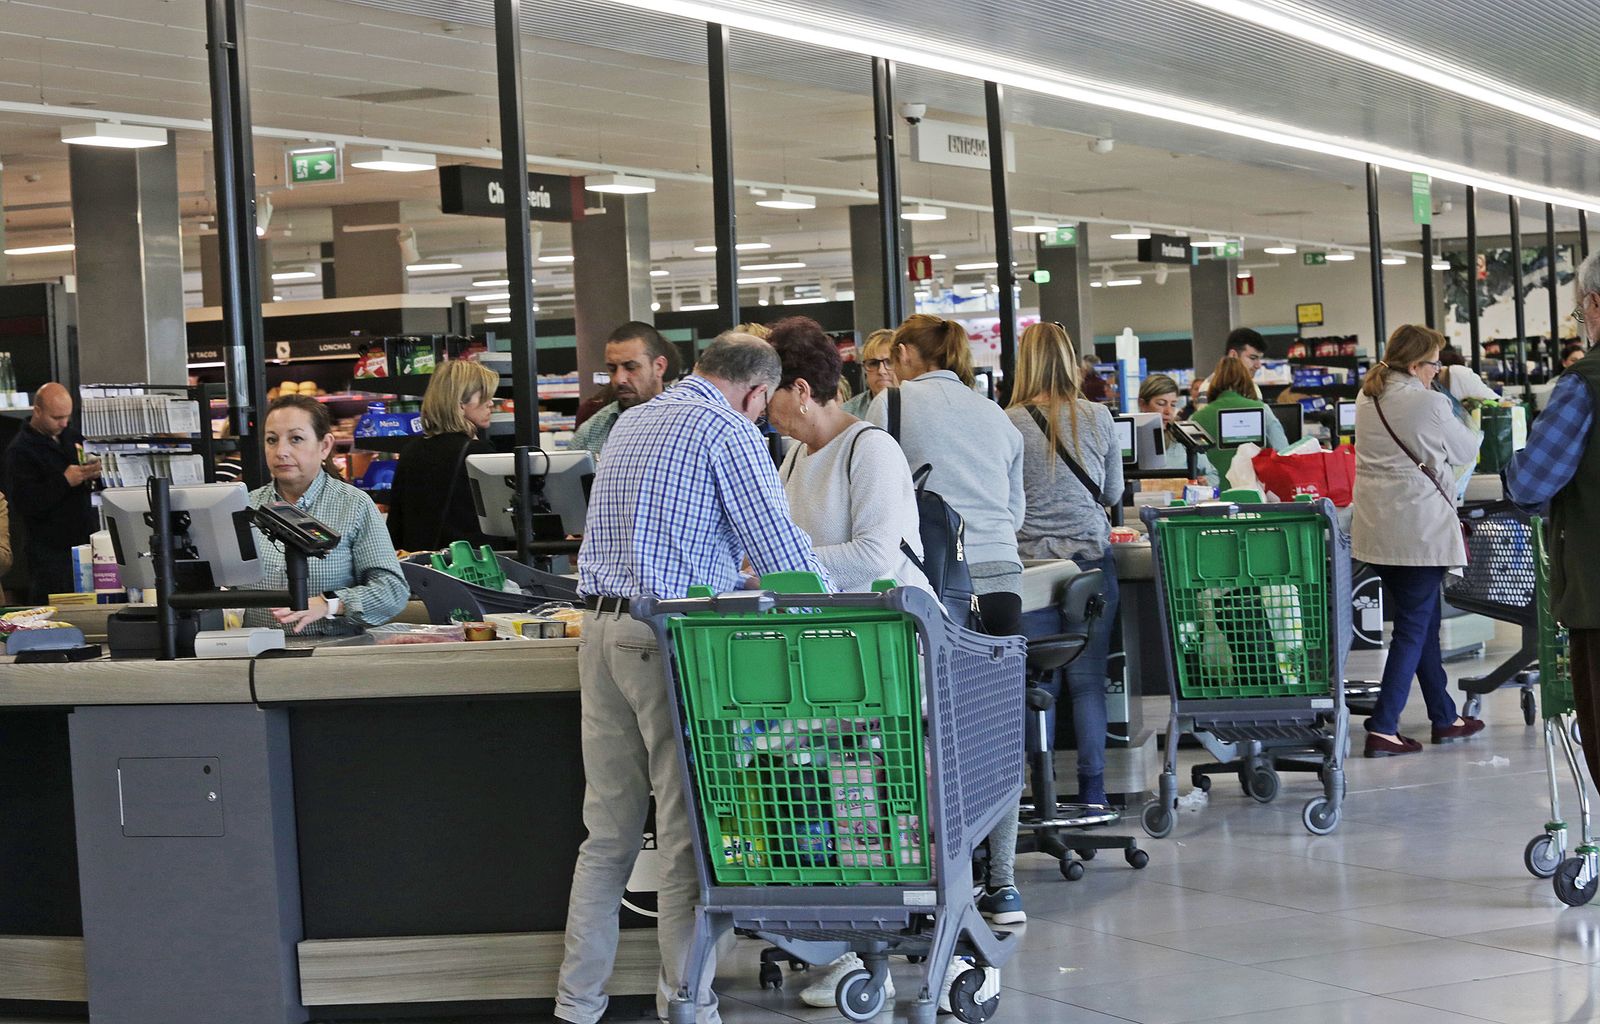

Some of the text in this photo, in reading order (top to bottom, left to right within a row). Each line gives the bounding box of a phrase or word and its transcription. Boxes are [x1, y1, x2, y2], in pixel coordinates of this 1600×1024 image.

[948, 135, 987, 157] ENTRADA
[487, 181, 551, 208] Chería
[319, 343, 351, 352] LONCHAS
